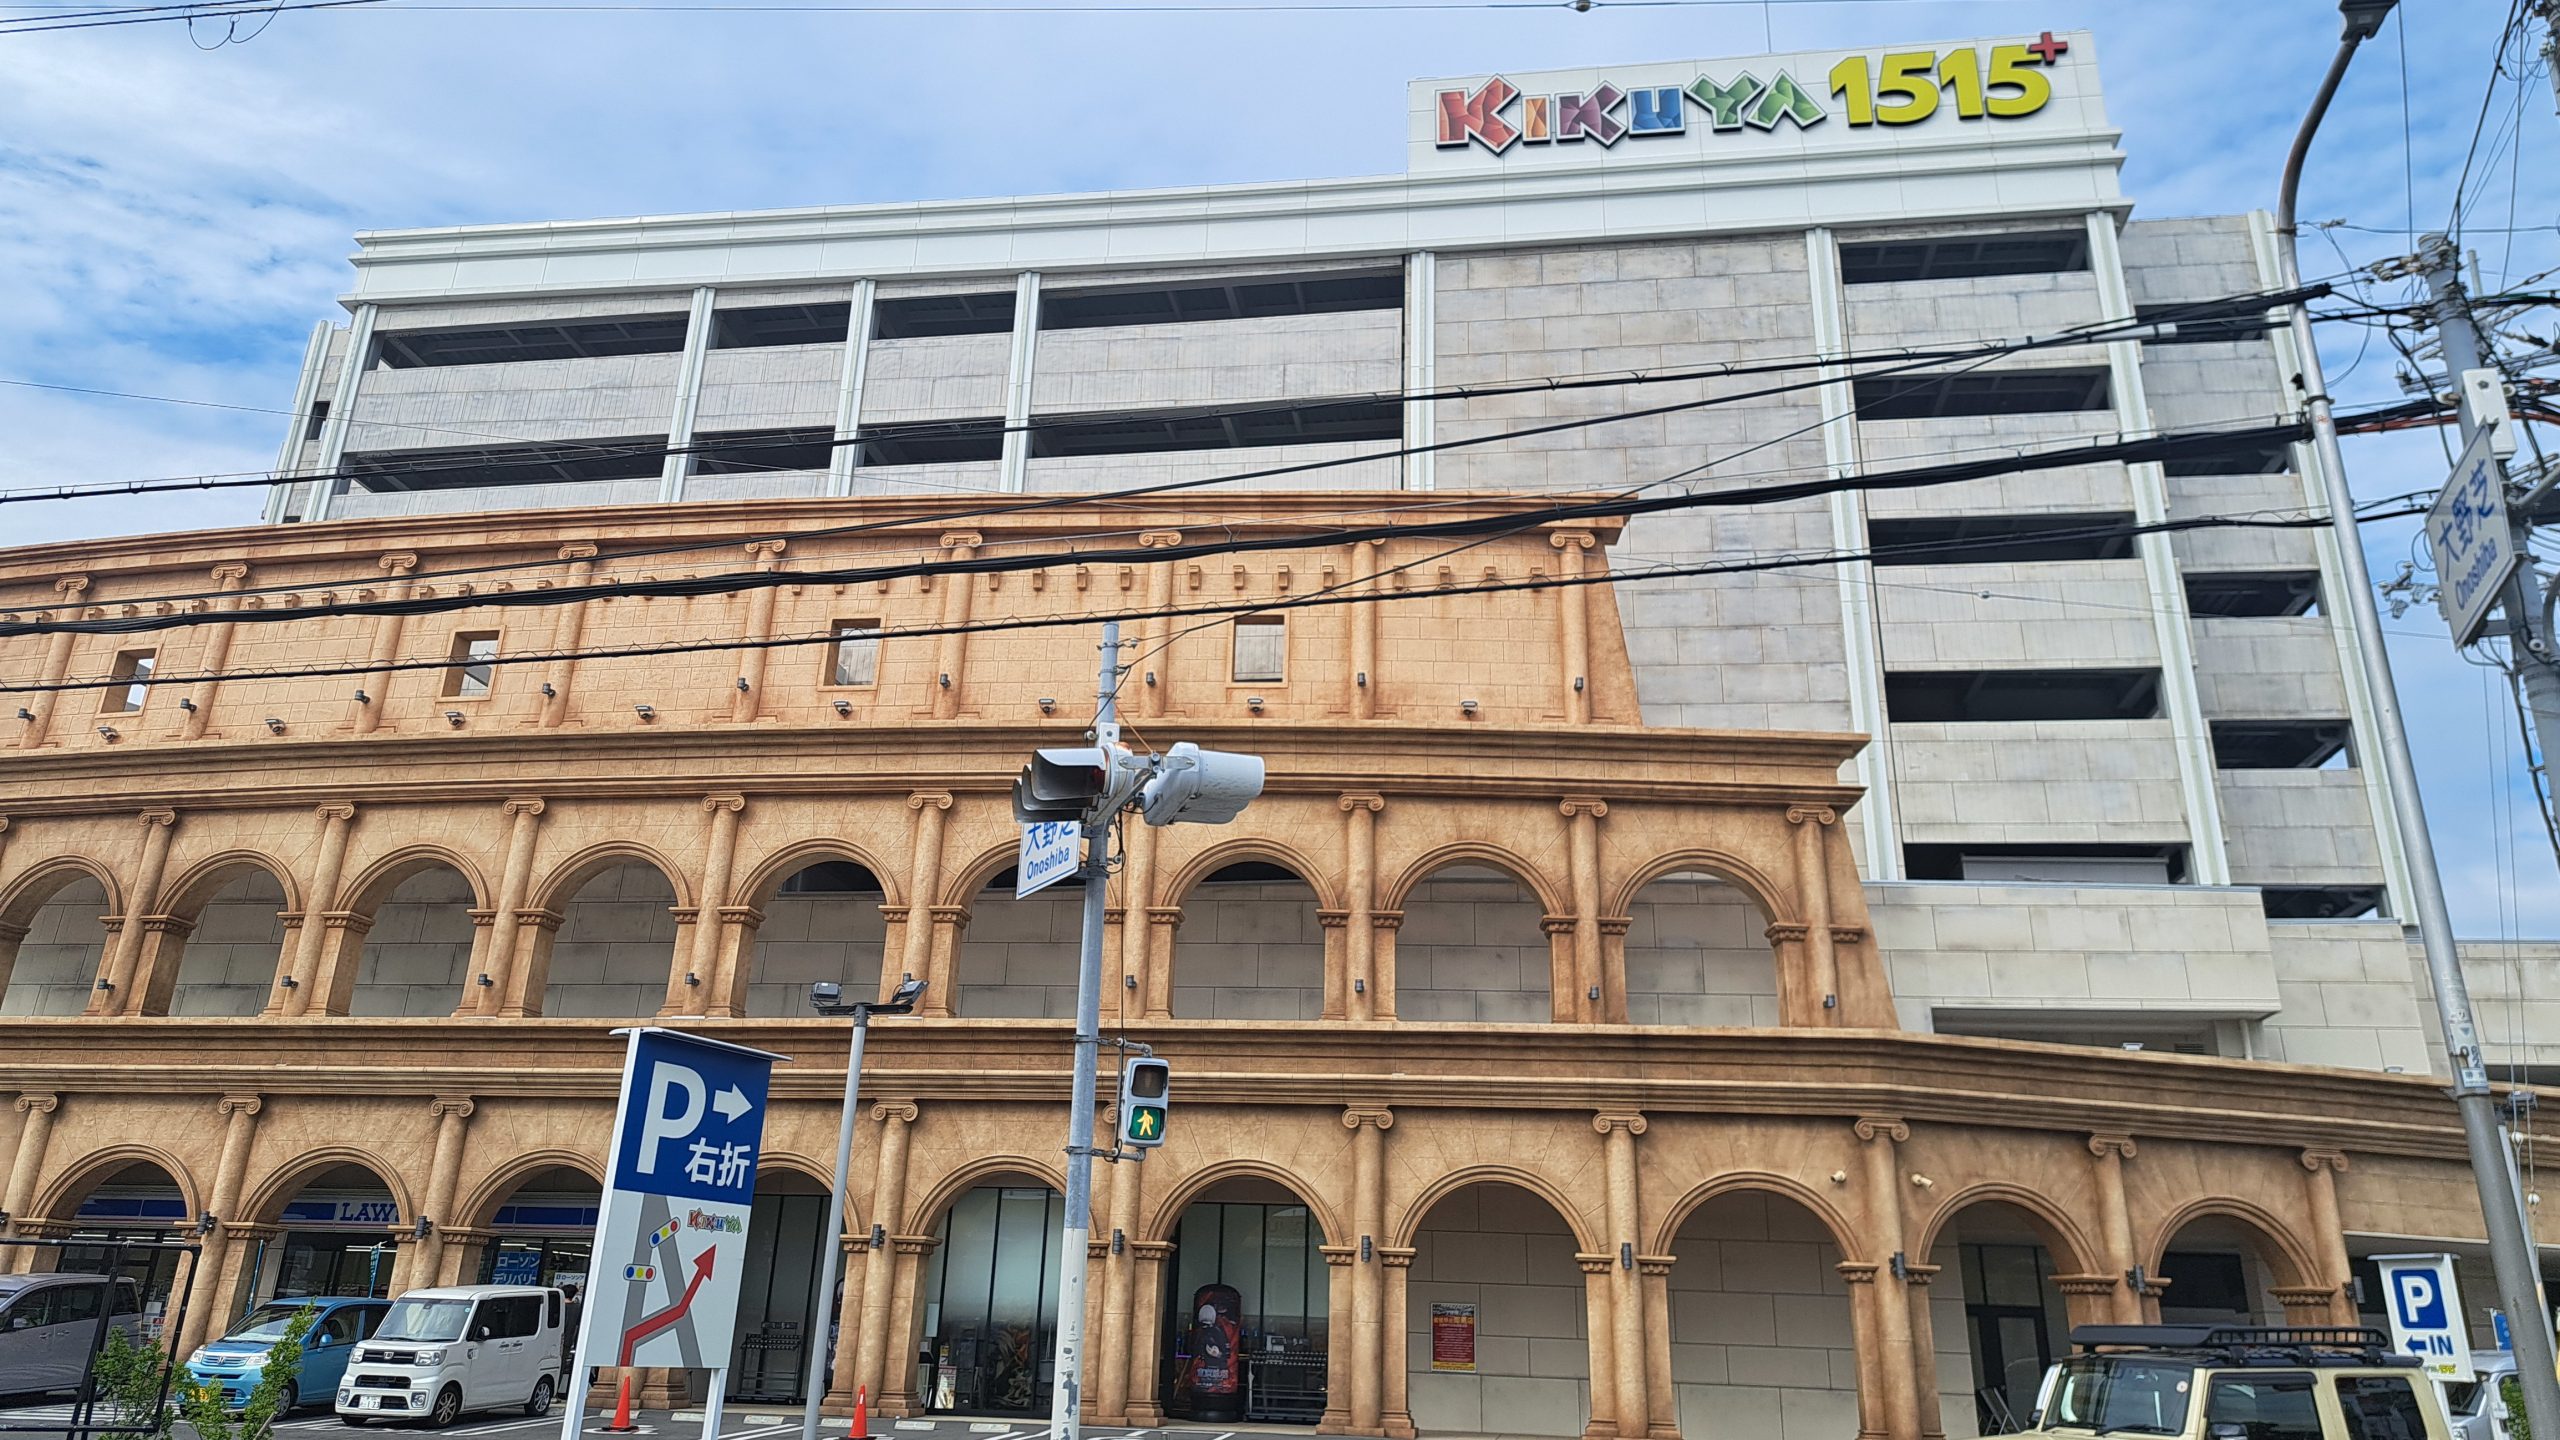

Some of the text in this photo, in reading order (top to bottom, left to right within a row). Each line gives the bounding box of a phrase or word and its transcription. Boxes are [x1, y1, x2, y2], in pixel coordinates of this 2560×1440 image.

[2438, 459, 2495, 582] 大野芝
[2455, 537, 2498, 610] Onoshiba
[1027, 846, 1070, 880] Onoshiba
[636, 1061, 707, 1175] P
[684, 1137, 751, 1189] 右折
[340, 1202, 399, 1222] LAW
[497, 1257, 540, 1267] ローソン
[2400, 1276, 2432, 1322] P
[2429, 1335, 2454, 1356] IN
